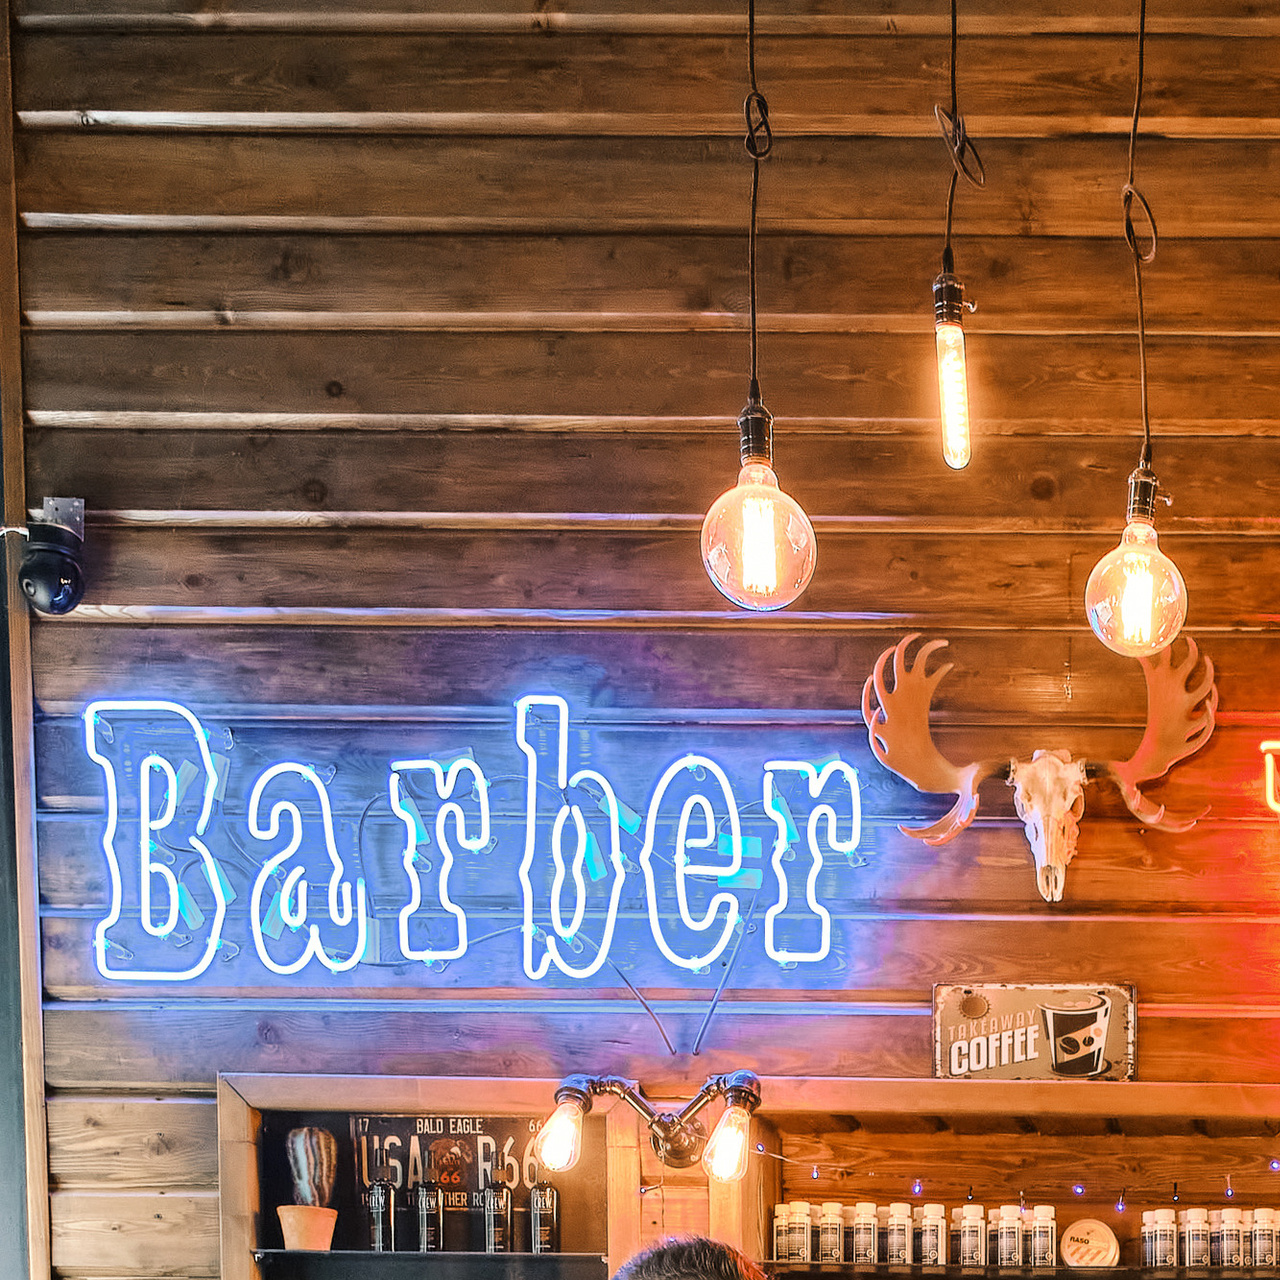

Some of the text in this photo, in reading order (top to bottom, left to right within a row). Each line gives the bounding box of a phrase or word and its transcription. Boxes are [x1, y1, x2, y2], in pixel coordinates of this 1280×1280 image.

[84, 694, 862, 982] Barber
[949, 1009, 1036, 1041] TAKEAWAY
[950, 1024, 1039, 1076] COFFEE
[358, 1118, 369, 1132] 17
[416, 1118, 483, 1134] BALD EAGLE
[361, 1135, 422, 1190] USA
[440, 1171, 461, 1184] 66
[534, 1197, 553, 1209] CREW
